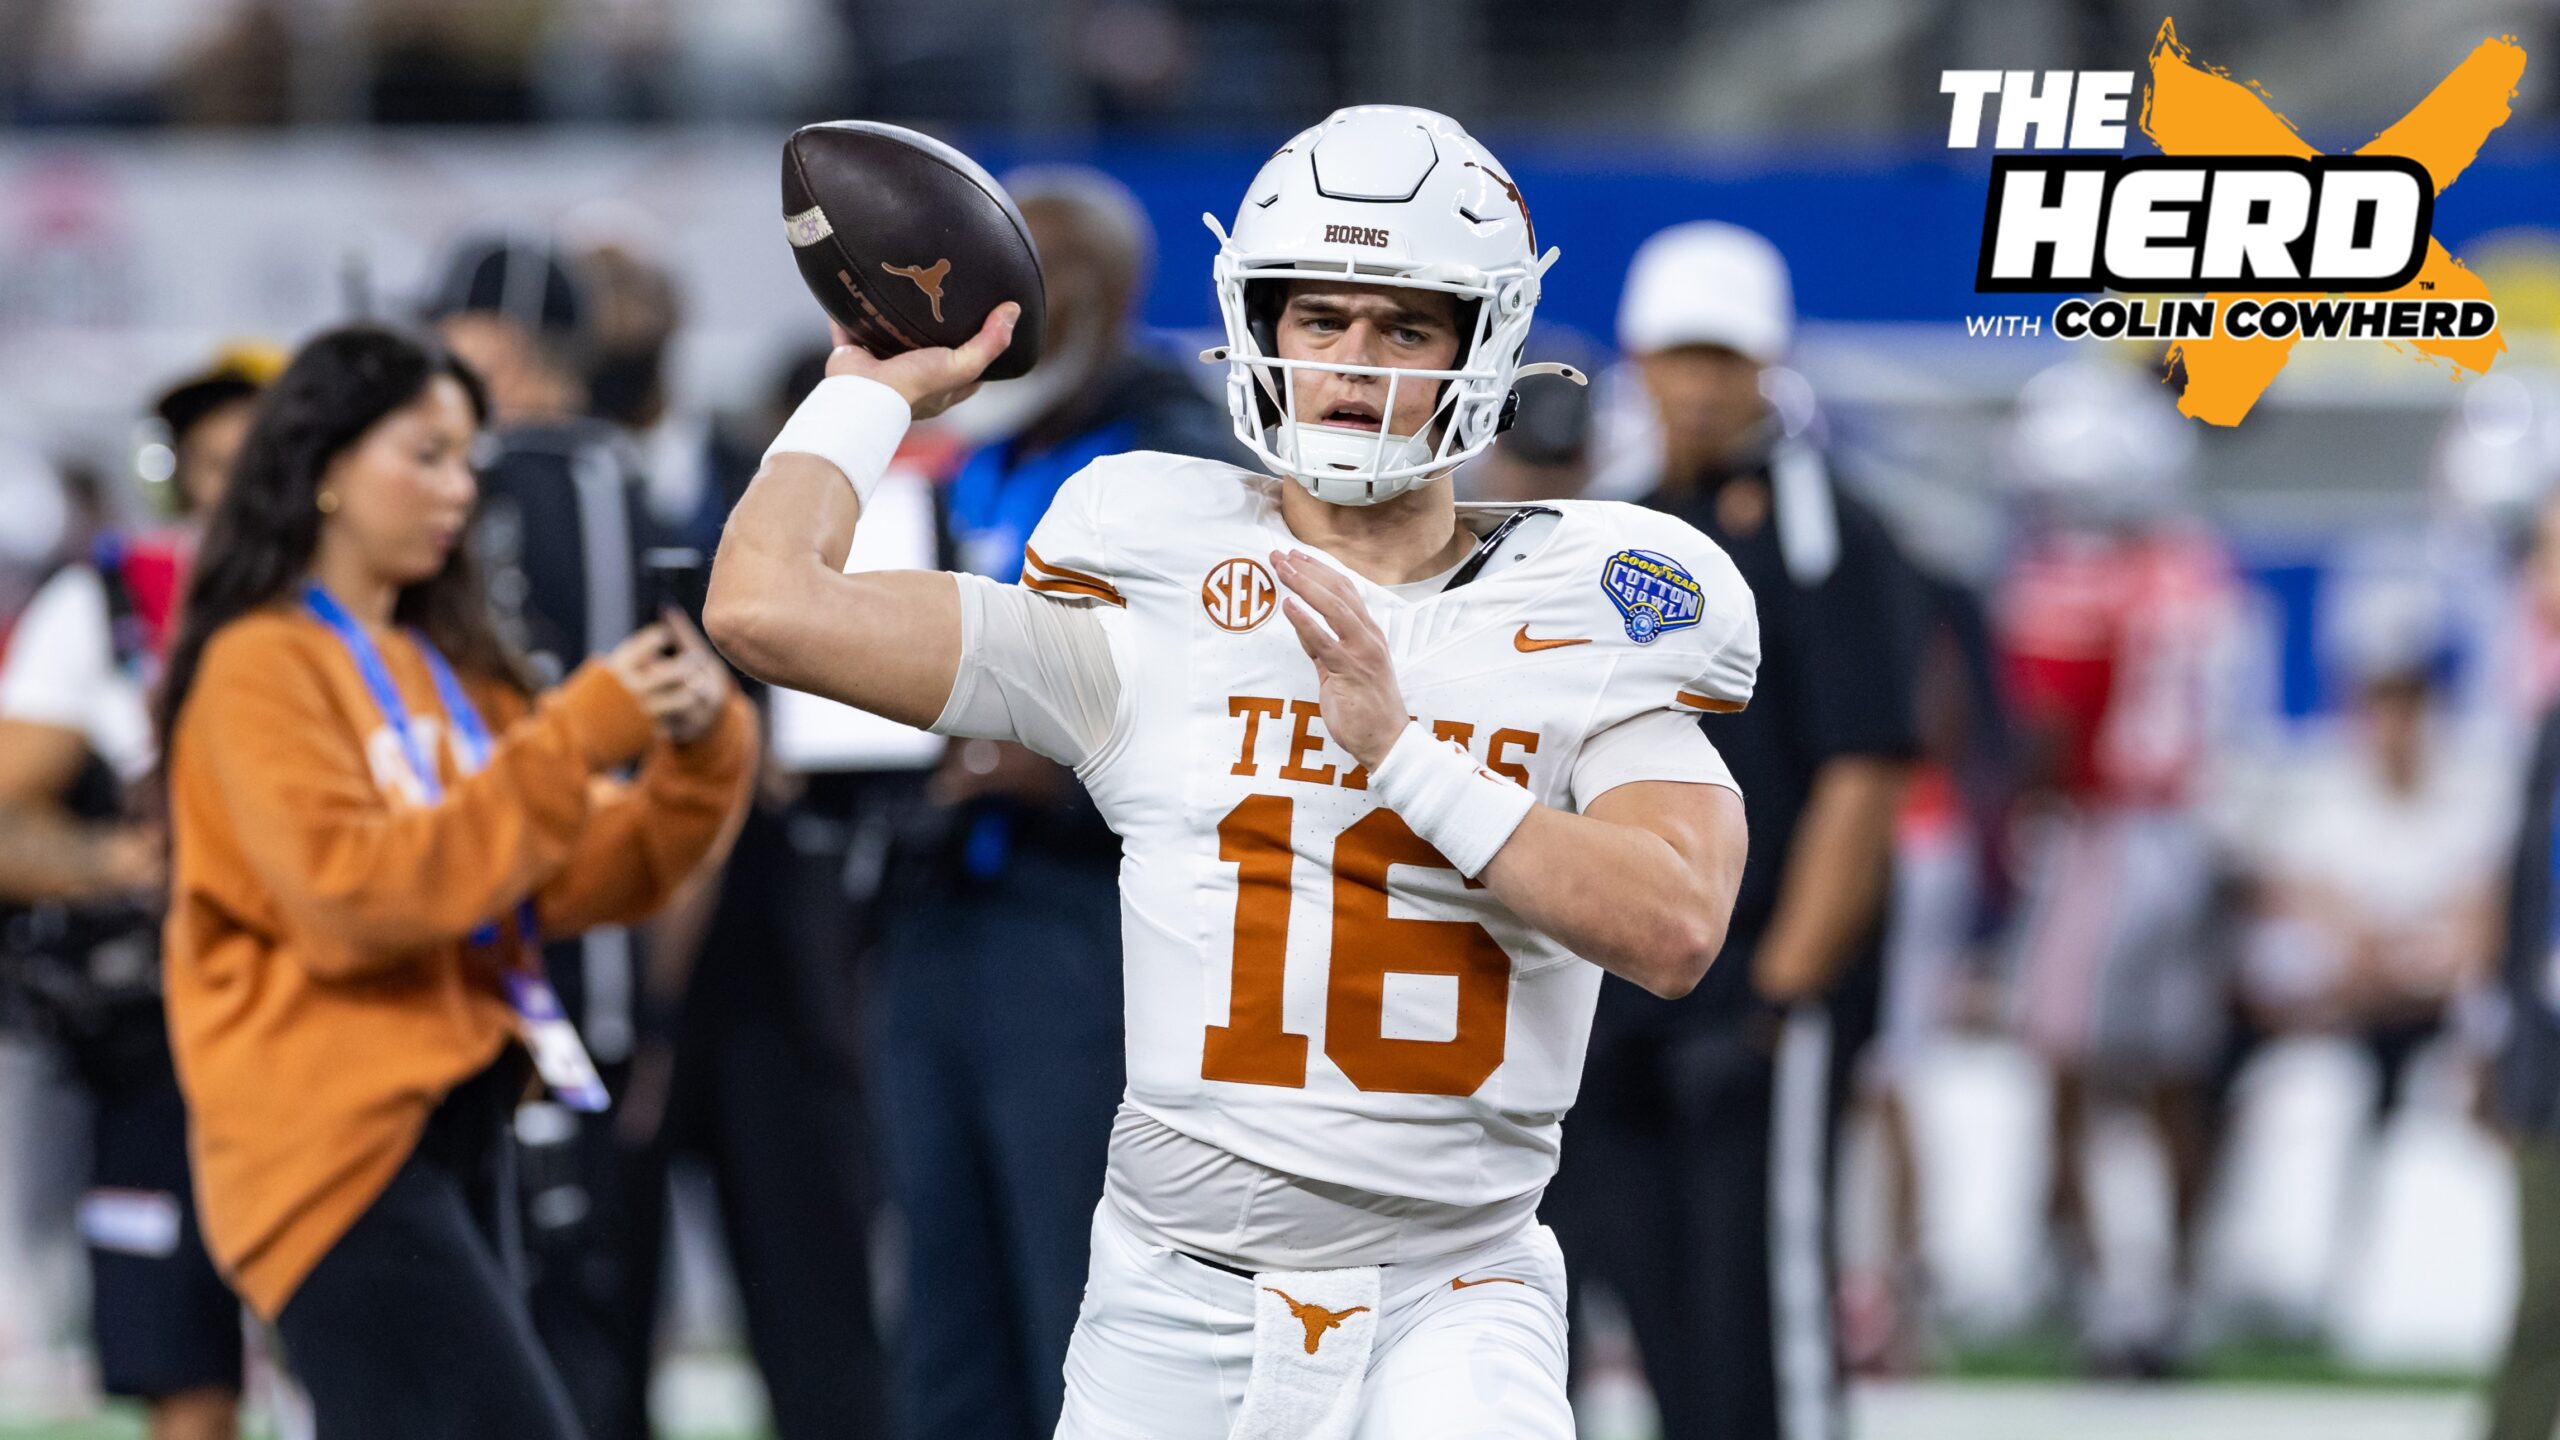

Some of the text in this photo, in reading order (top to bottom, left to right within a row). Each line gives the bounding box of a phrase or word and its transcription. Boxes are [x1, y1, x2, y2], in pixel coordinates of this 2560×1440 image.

[1323, 224, 1390, 248] HORNS
[1207, 561, 1274, 627] SEC
[1610, 563, 1699, 618] COTTON
[1623, 585, 1678, 618] BOWL
[1629, 606, 1661, 628] CLASSIC
[1228, 696, 1540, 791] TES
[1201, 793, 1511, 1098] 16
